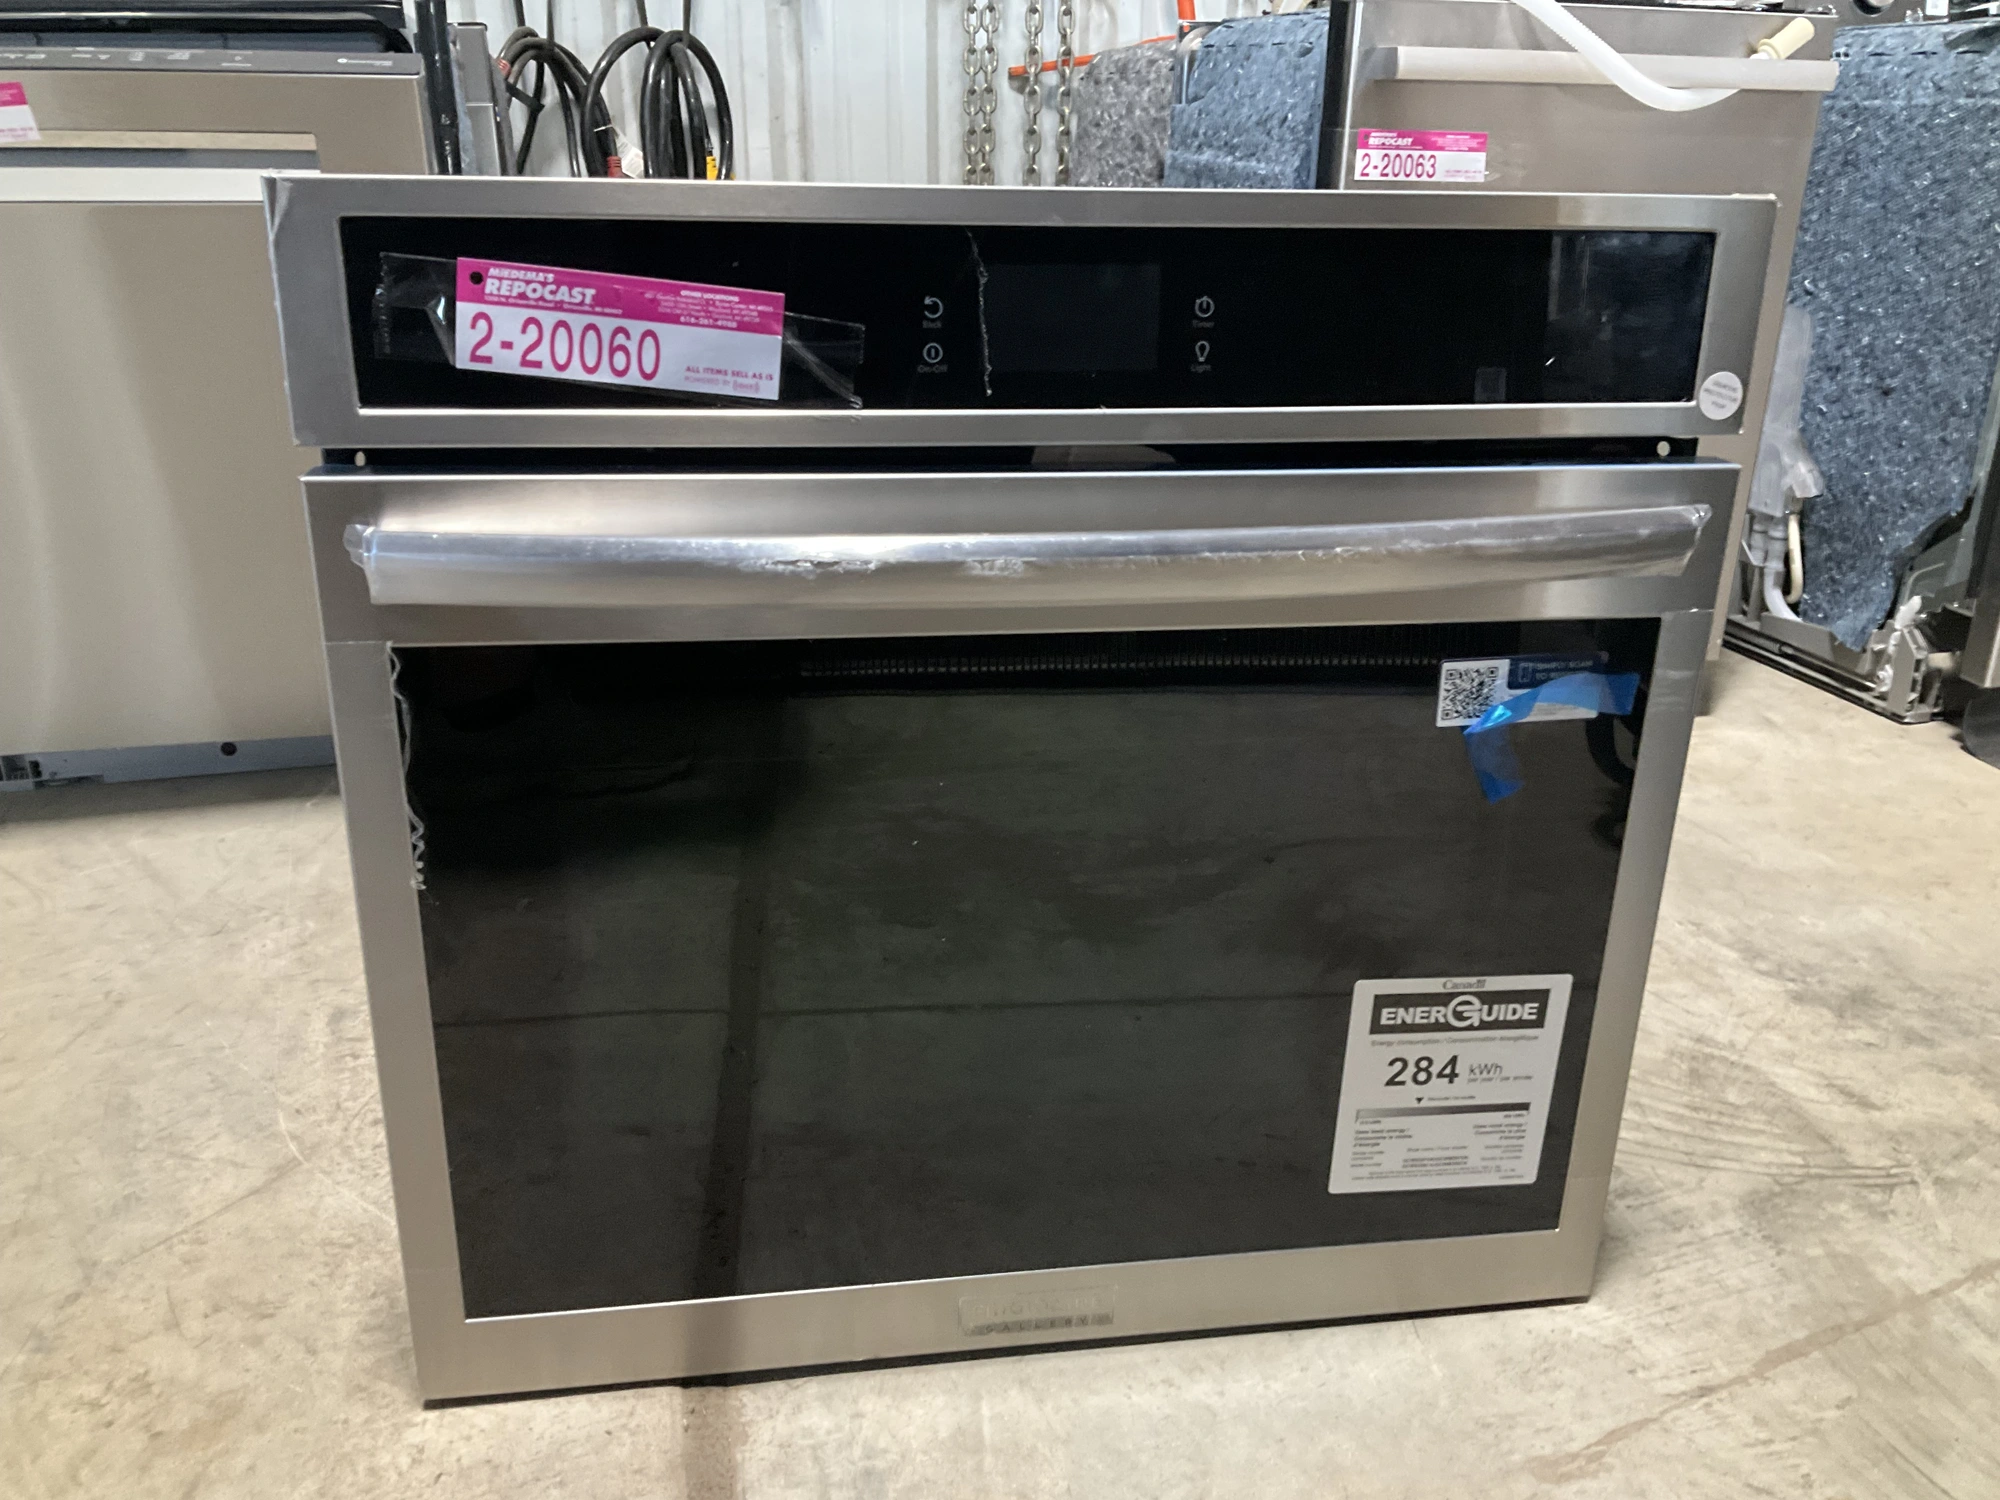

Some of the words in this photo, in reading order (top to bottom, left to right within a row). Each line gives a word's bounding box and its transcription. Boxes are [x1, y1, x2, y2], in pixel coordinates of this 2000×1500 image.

[1360, 153, 1437, 179] 2-20063
[487, 267, 554, 283] MIEDEMA'S
[484, 278, 596, 305] REPOCAST
[469, 311, 661, 381] 2-20060
[685, 366, 700, 374] ALL
[703, 367, 728, 376] ITEMS
[731, 370, 749, 378] SELL
[751, 372, 763, 380] AS
[765, 373, 774, 381] IS
[1380, 994, 1540, 1028] ENERGUIDE
[1384, 1054, 1460, 1087] 284
[1468, 1062, 1503, 1076] kWh
[985, 1317, 1087, 1333] GALLERY
